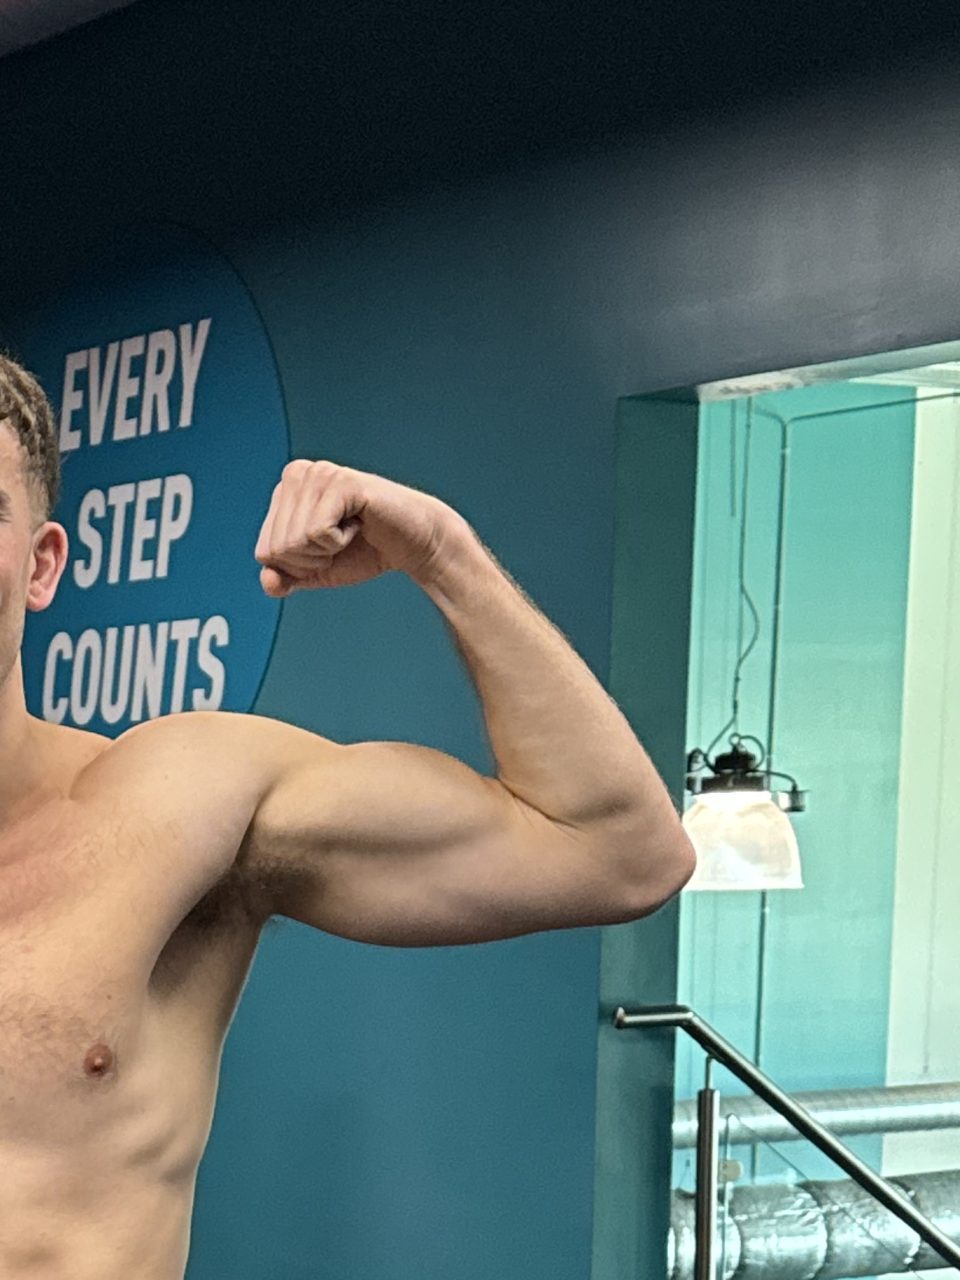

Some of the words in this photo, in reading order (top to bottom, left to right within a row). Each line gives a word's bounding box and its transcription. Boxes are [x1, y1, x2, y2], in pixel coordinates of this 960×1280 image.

[59, 318, 212, 453] EVERY
[73, 473, 194, 590] STEP
[42, 615, 230, 726] COUNTS
